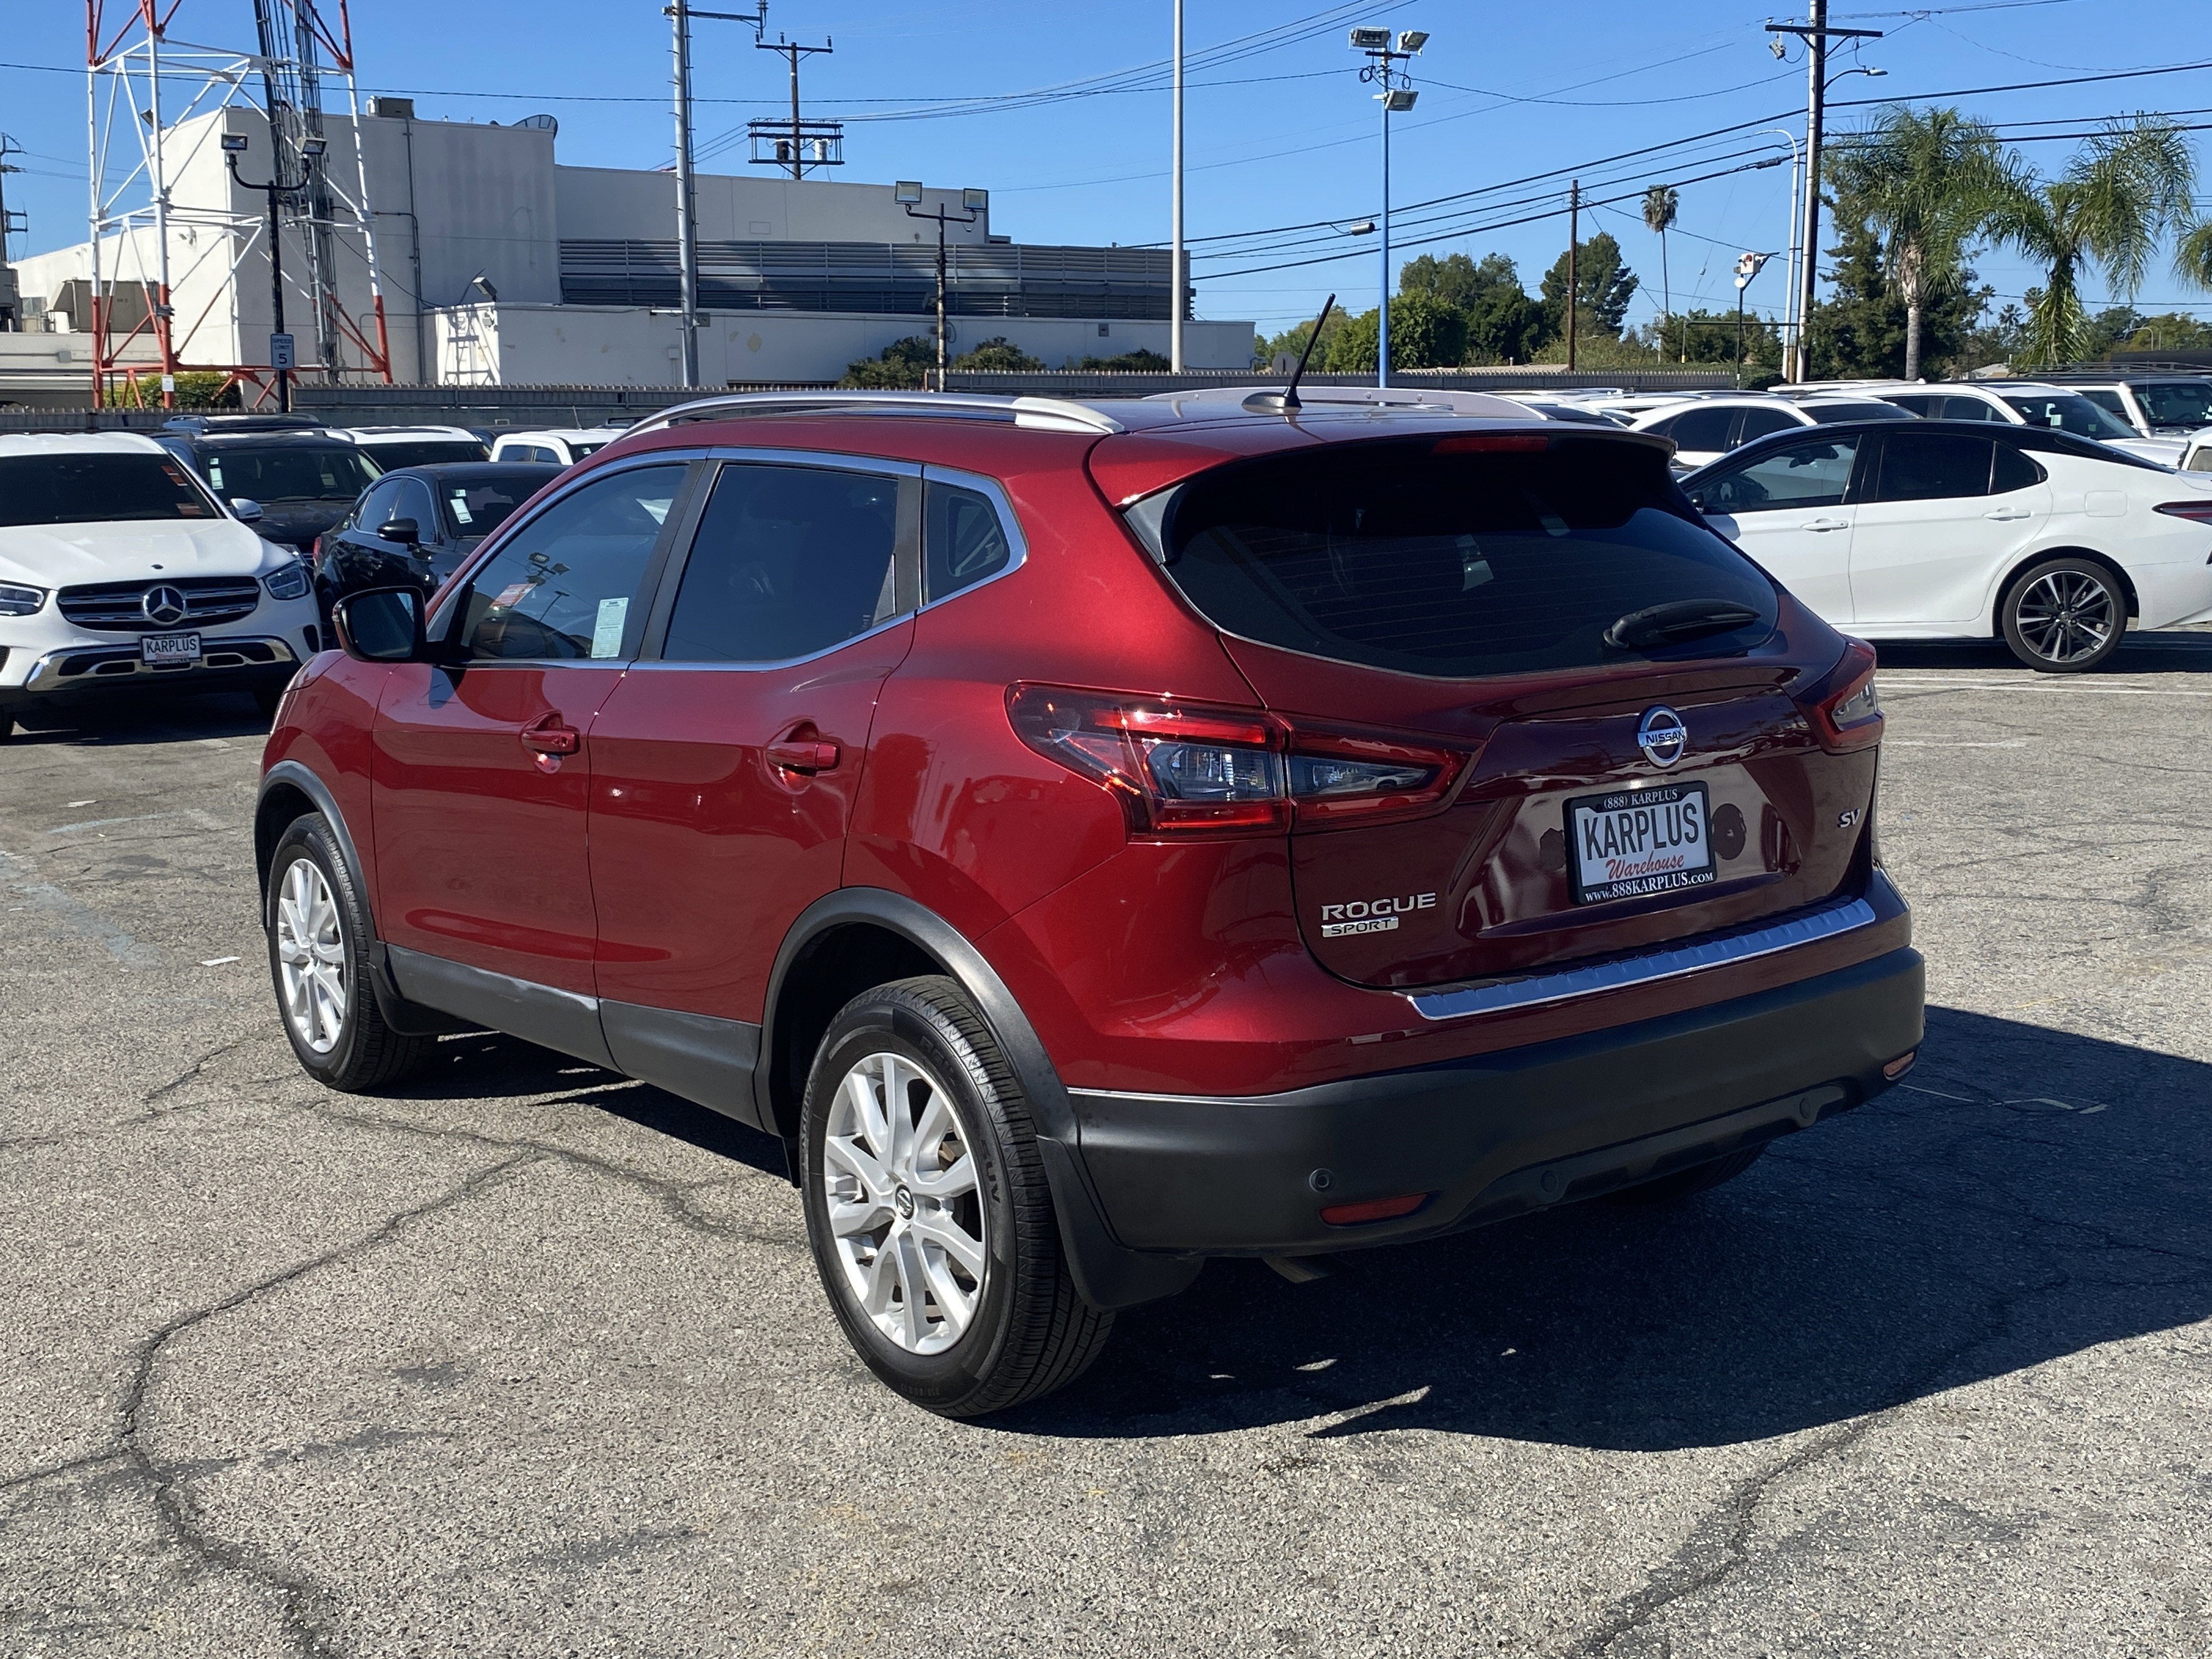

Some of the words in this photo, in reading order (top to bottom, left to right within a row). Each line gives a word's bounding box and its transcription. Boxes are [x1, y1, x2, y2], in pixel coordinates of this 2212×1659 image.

[278, 353, 287, 364] 5
[146, 638, 197, 653] KARPLUS
[1646, 731, 1686, 743] NISSAN
[1603, 795, 1628, 810] (888)
[1631, 788, 1678, 806] KARPLUS
[1837, 808, 1861, 828] SV
[1583, 802, 1699, 861] KARPLUS
[1605, 850, 1685, 881] Warehouse
[1321, 892, 1437, 921] ROGUE
[1331, 919, 1391, 935] SPORT
